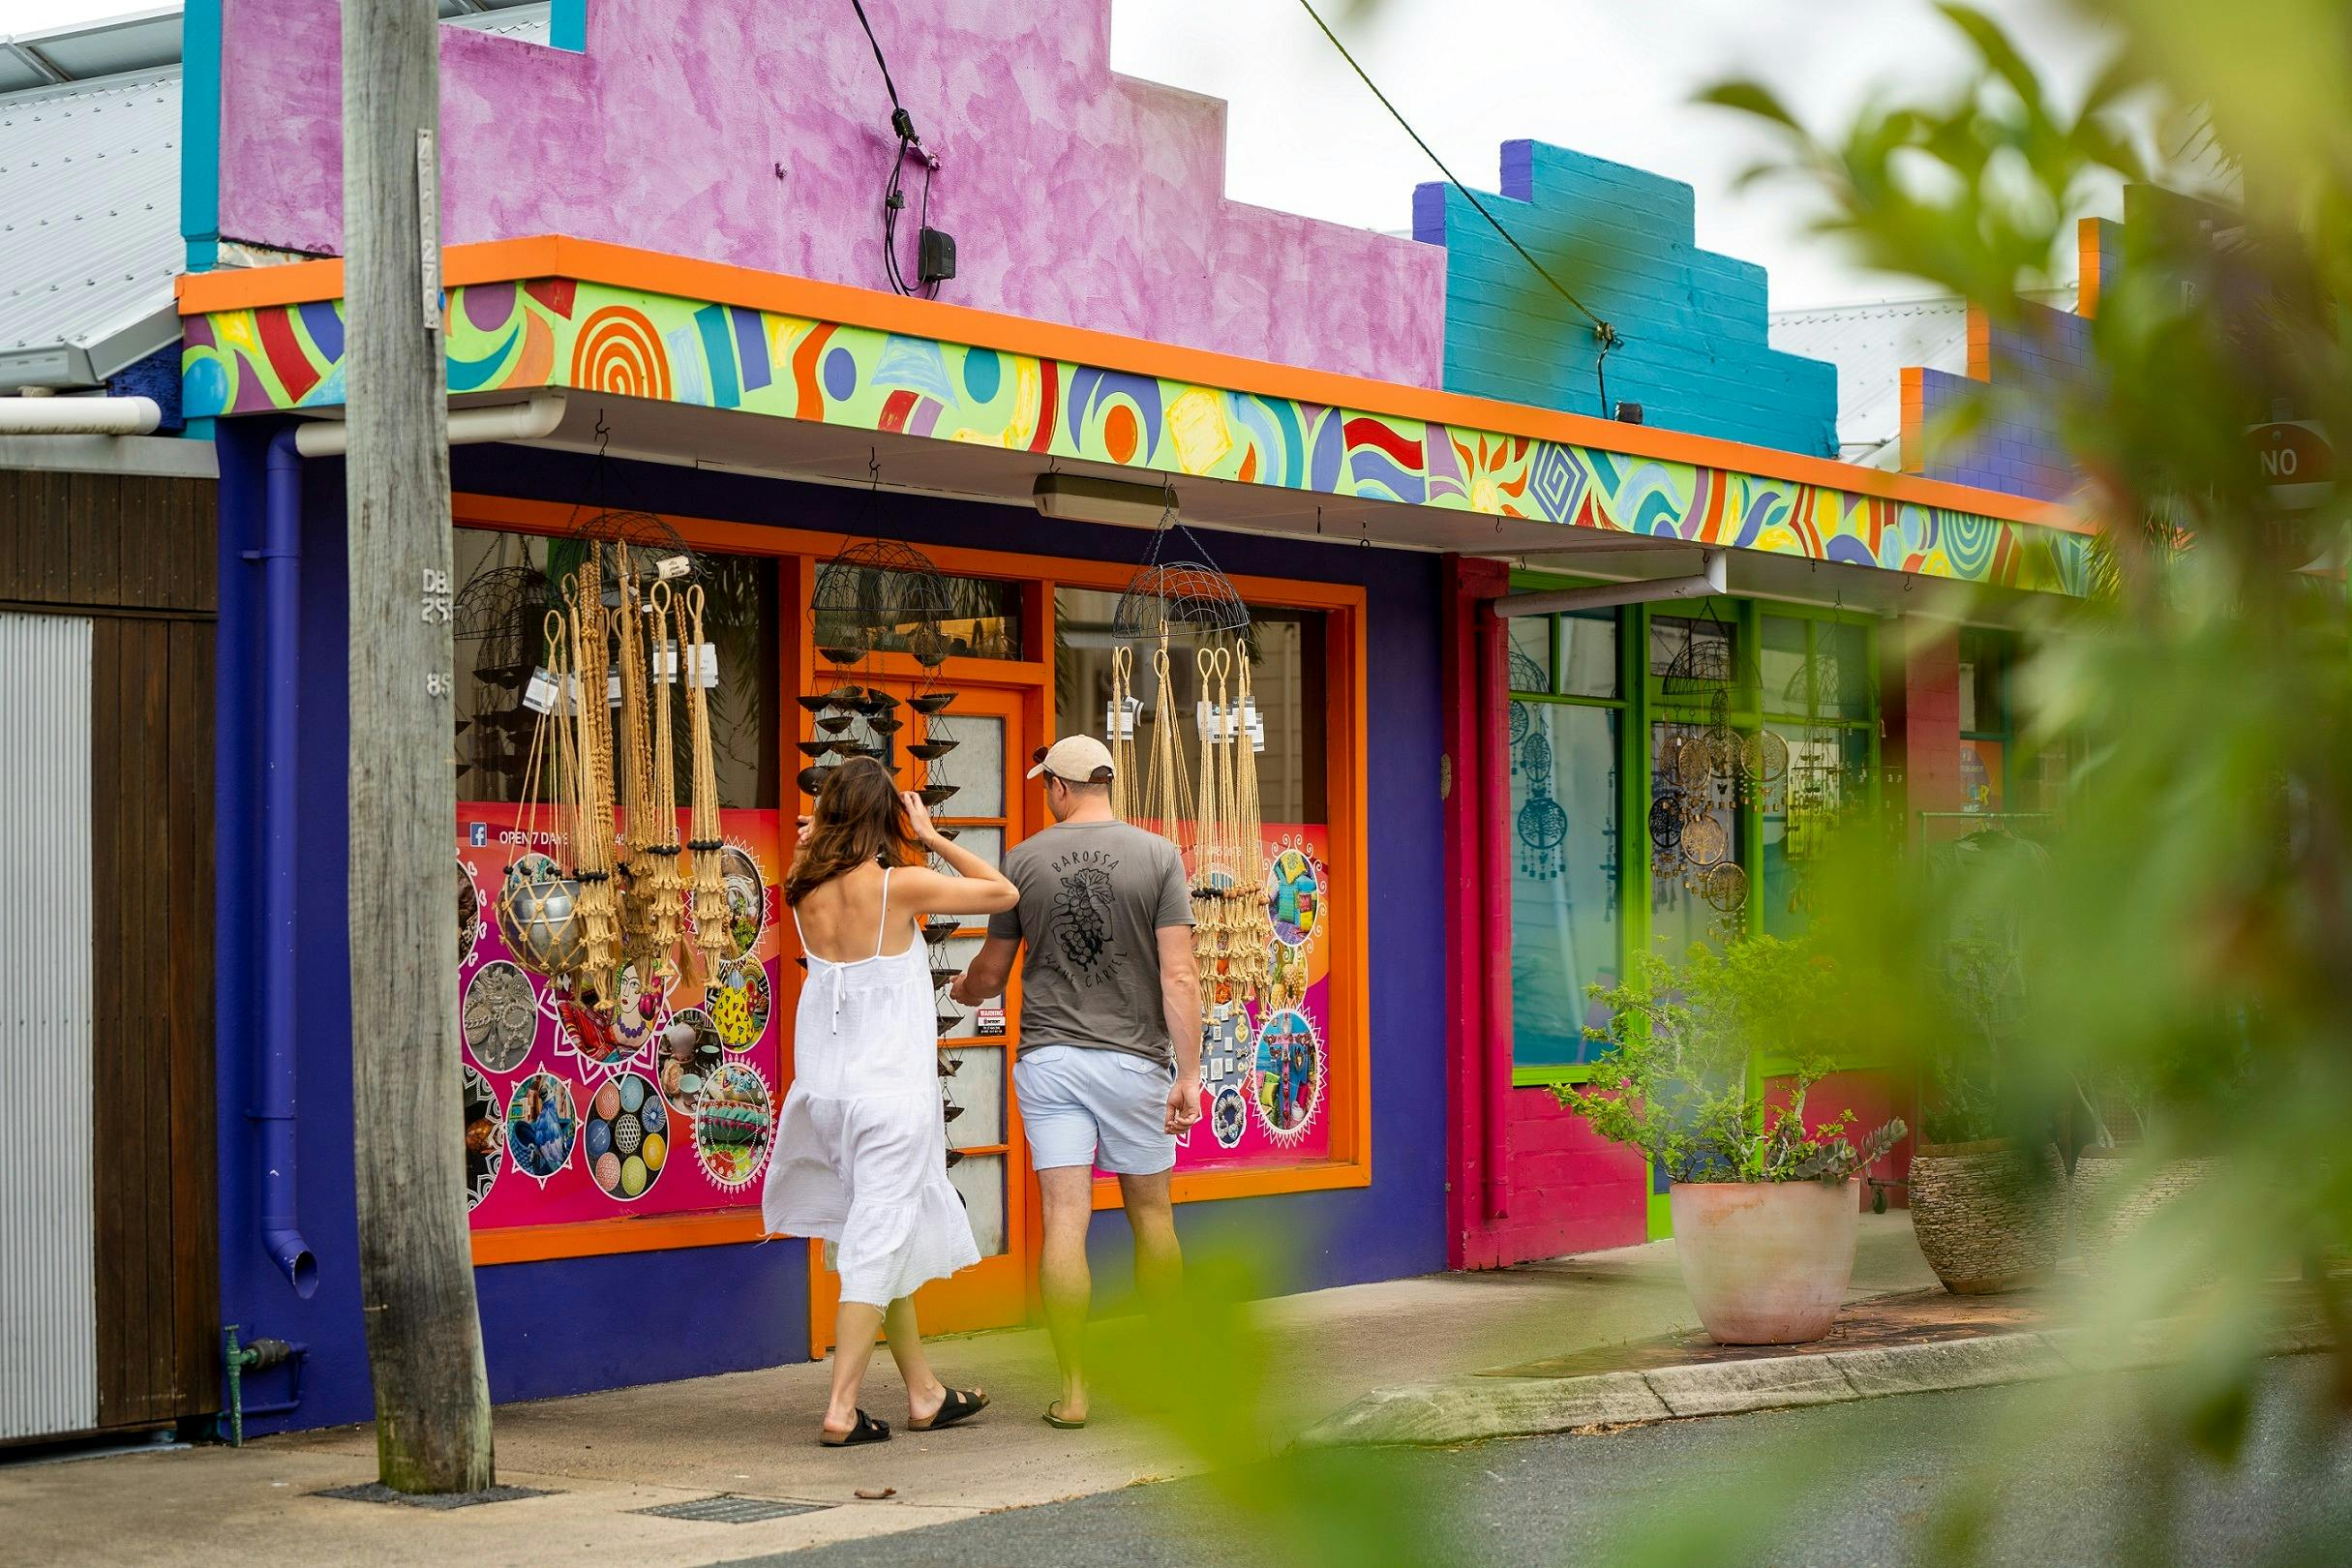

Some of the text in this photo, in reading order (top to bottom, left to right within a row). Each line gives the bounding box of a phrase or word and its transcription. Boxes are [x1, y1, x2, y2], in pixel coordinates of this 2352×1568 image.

[2260, 447, 2298, 476] NO
[499, 831, 529, 844] OPEN
[532, 831, 539, 845] 7
[1051, 851, 1120, 873] BAROSSA
[1044, 951, 1129, 988] WINE CARTEL
